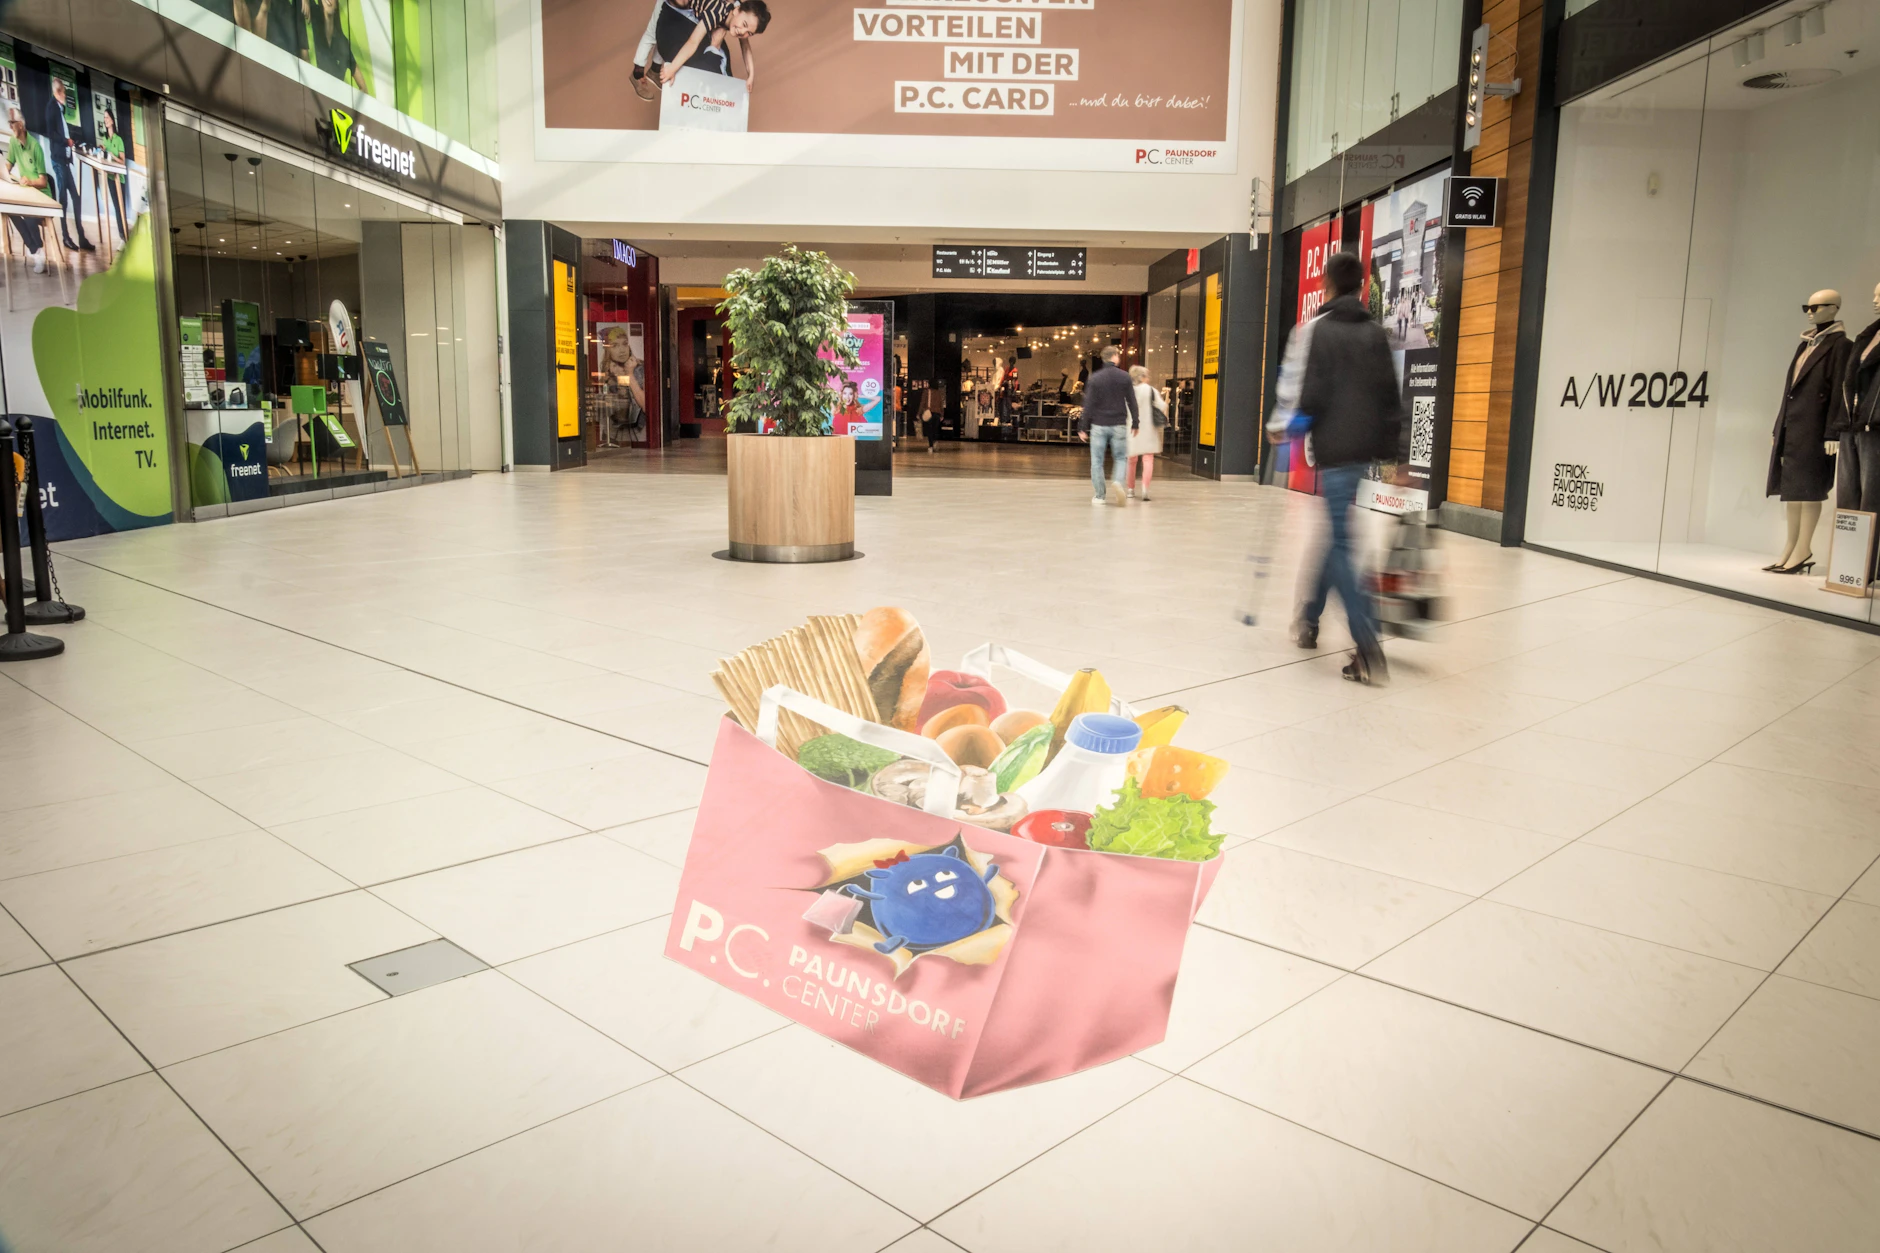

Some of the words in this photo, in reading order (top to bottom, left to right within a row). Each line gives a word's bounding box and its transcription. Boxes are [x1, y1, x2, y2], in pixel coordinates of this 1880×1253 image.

[858, 13, 1036, 39] VORTEILEN
[950, 52, 1004, 74] MIT
[1012, 52, 1074, 75] DER
[681, 92, 702, 110] P.C.
[703, 96, 736, 108] PAUNSDORF
[900, 86, 954, 109] P.C.
[962, 87, 1049, 110] CARD
[1111, 94, 1129, 107] du
[1135, 94, 1164, 108] bist
[1166, 95, 1211, 109] dabei!
[702, 104, 721, 113] CENTER
[356, 124, 416, 179] freenet
[1135, 149, 1163, 165] P.C.
[1165, 150, 1217, 158] PAUNSDORF
[1165, 157, 1194, 165] CENTER
[612, 238, 637, 268] IMAGO
[1306, 246, 1320, 280] P.C.
[81, 388, 152, 408] Mobilfunk.
[1560, 373, 1626, 410] A/W
[1628, 371, 1710, 408] 2024
[93, 421, 154, 440] Internet.
[135, 450, 157, 469] TV.
[231, 462, 262, 477] freenet
[1554, 463, 1590, 479] STRICK-
[1553, 478, 1604, 497] FAVORITEN
[1376, 494, 1405, 509] PAUNSDORF
[1552, 493, 1565, 507] AB
[1567, 494, 1589, 511] 19,99
[1590, 498, 1598, 512] €
[1839, 574, 1855, 585] 9,99
[1856, 577, 1862, 586] €
[679, 898, 771, 988] P.C.
[788, 944, 968, 1040] PAUNSDORF
[782, 975, 881, 1035] CENTER
